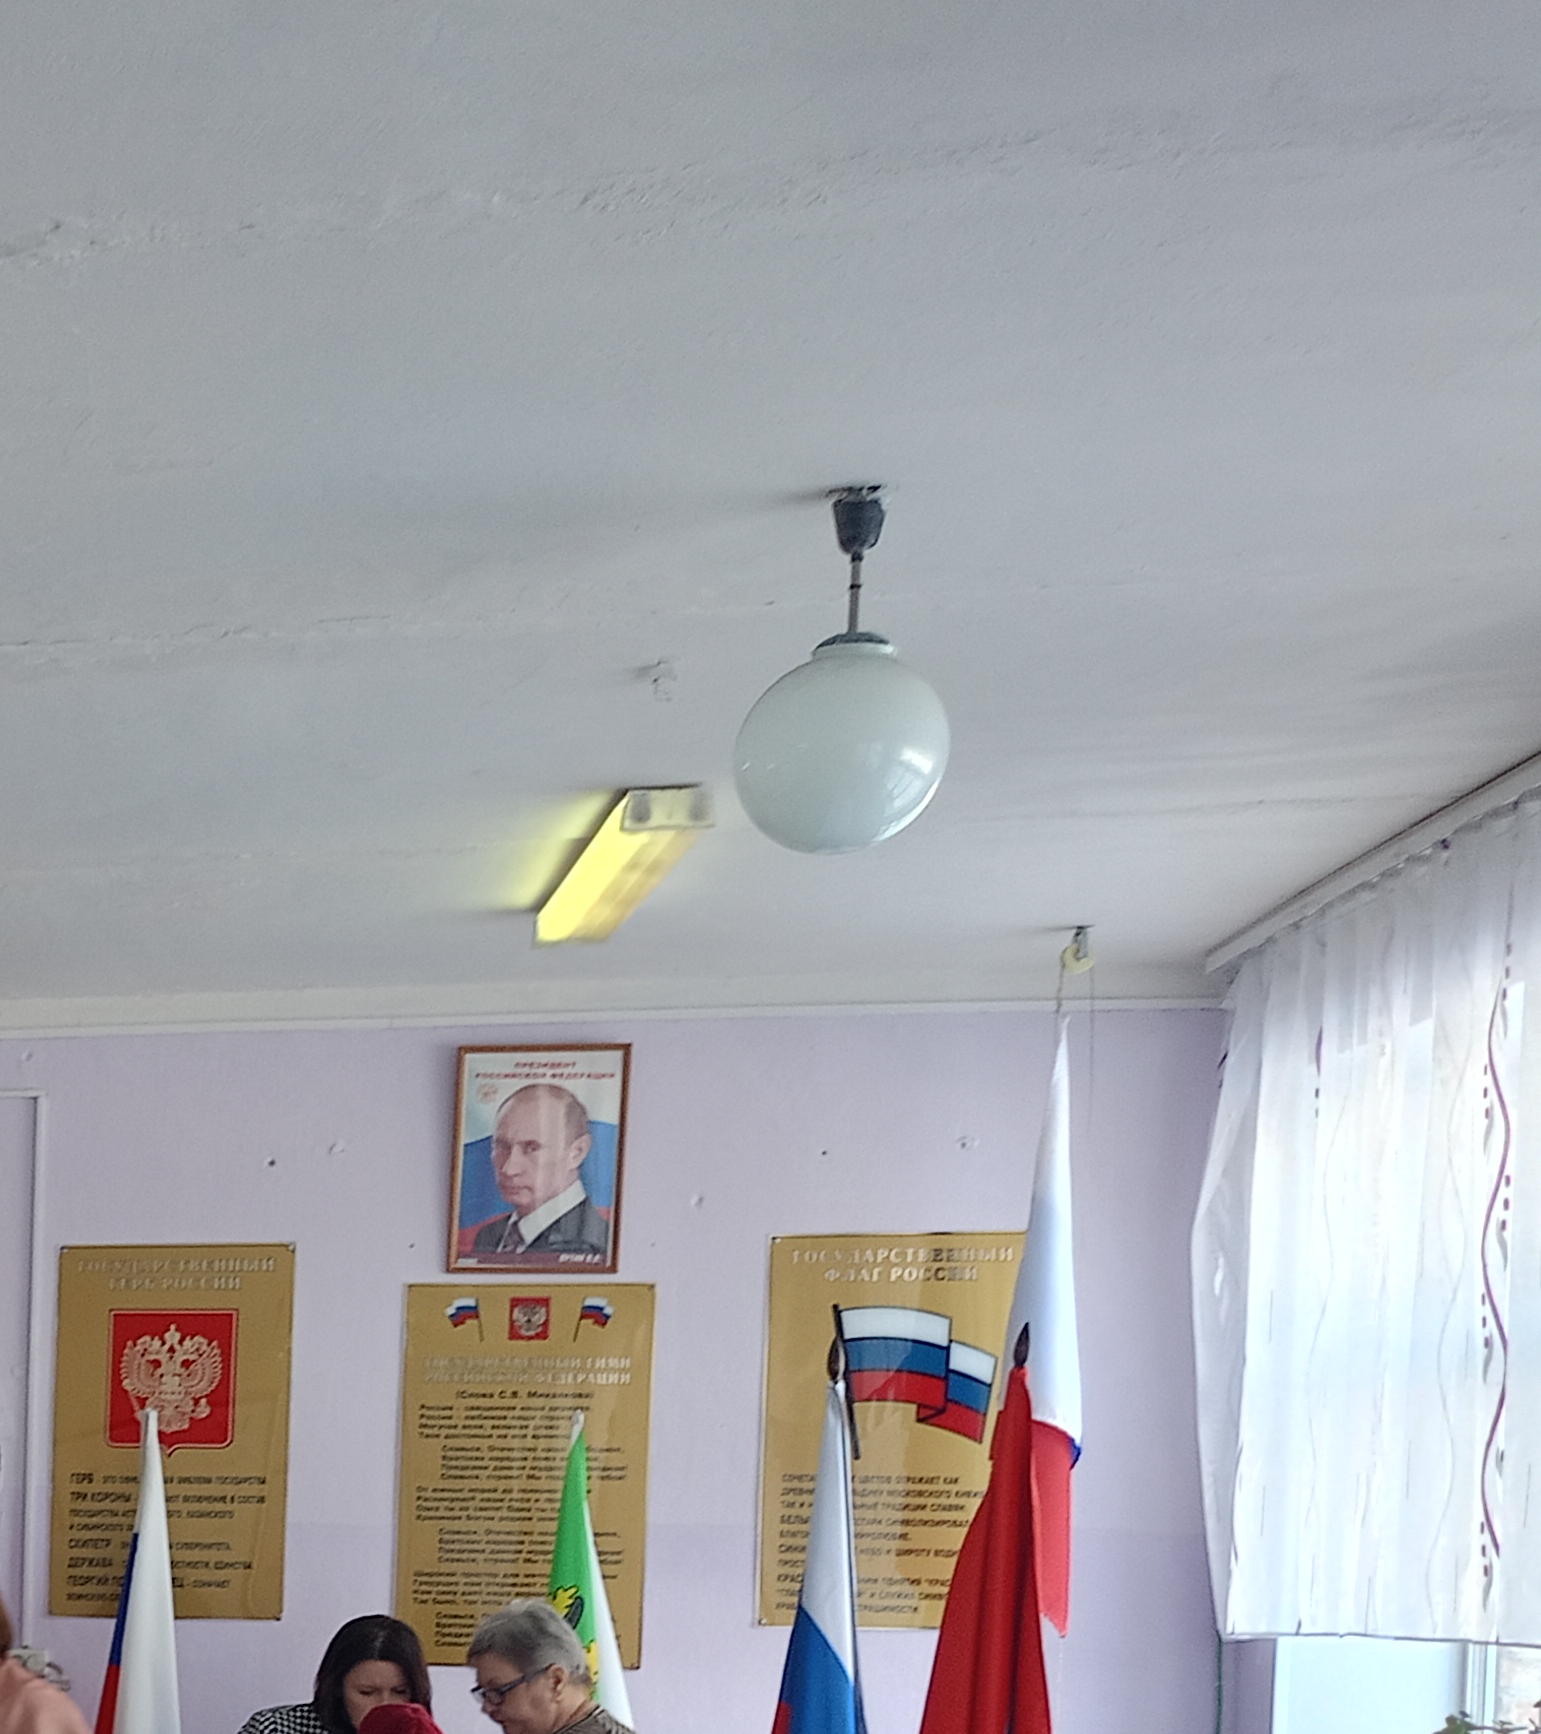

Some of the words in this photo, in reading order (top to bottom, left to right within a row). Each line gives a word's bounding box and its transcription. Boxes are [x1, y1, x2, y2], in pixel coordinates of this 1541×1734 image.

[791, 1246, 1014, 1265] ГОСУДАРСТВЕННЫЙ
[824, 1266, 884, 1283] ФЛАГ
[888, 1266, 979, 1283] РОССИИ
